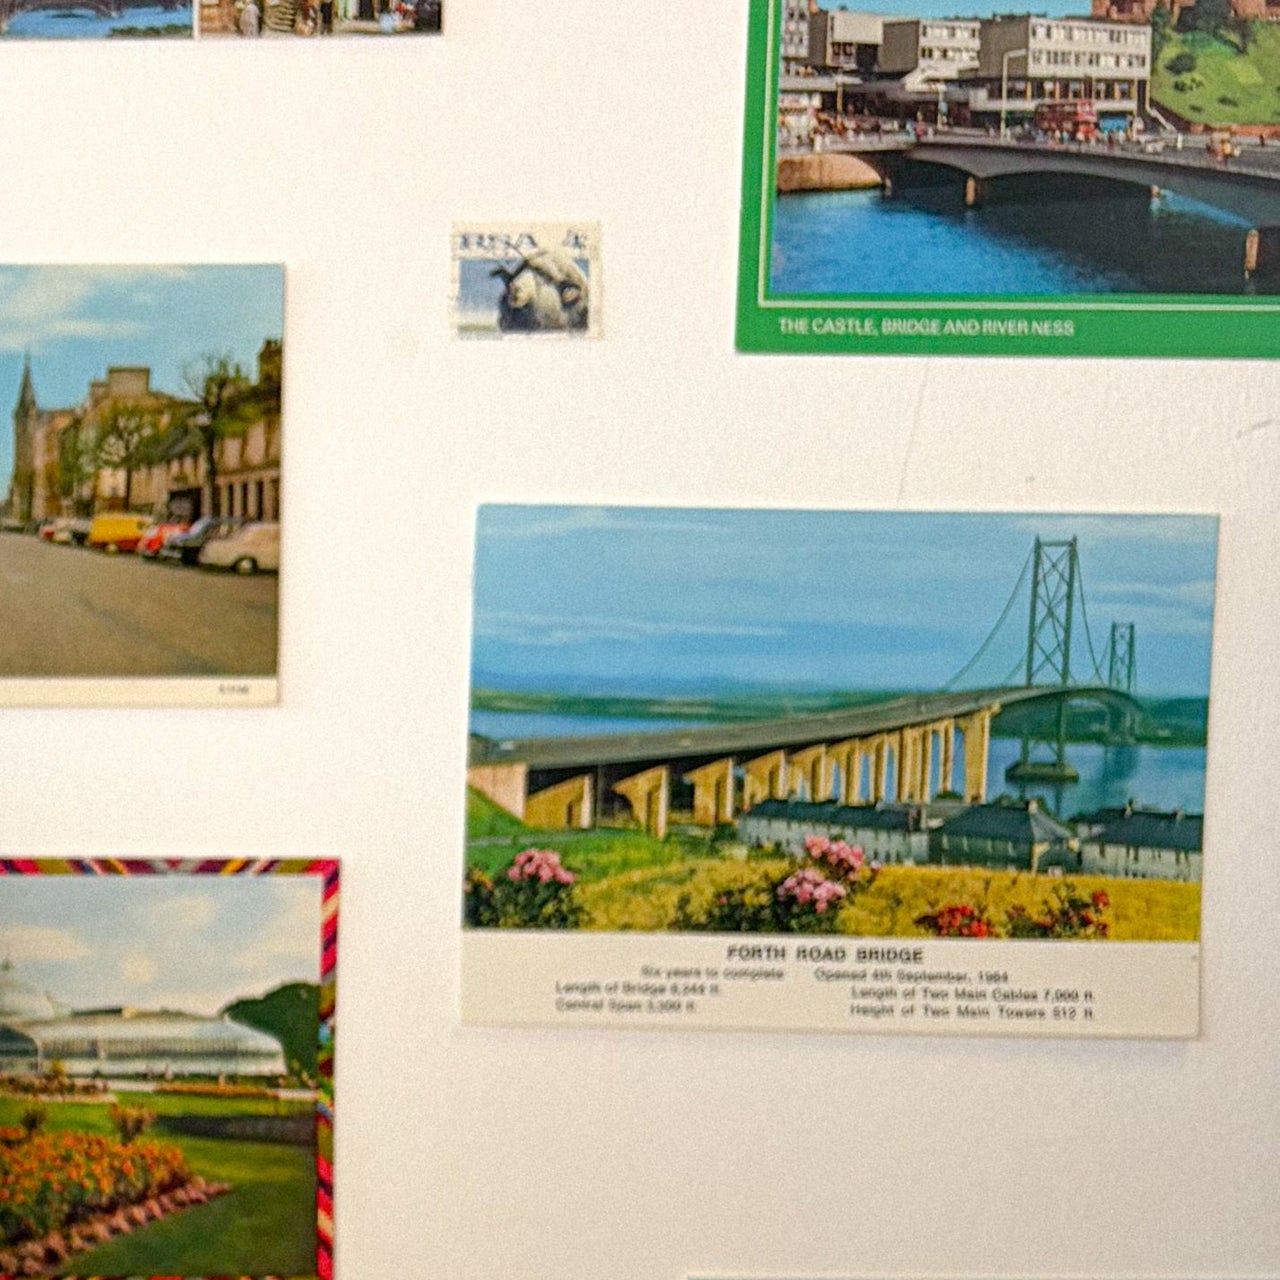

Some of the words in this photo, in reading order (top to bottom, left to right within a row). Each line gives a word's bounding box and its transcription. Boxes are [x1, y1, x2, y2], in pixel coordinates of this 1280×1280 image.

[780, 316, 808, 334] THE
[812, 317, 878, 336] CASTLE,
[881, 318, 940, 336] BRIDGE
[944, 319, 981, 336] AND
[982, 319, 1028, 336] RIVER
[1031, 319, 1075, 336] NESS
[726, 944, 786, 961] FORTH
[796, 945, 846, 962] ROAD
[856, 947, 924, 963] BRIDGE
[705, 965, 719, 977] to
[722, 966, 784, 981] complete
[814, 969, 867, 983] Opened
[871, 969, 892, 982] 4th
[555, 980, 601, 996] Length
[605, 981, 619, 994] of
[621, 981, 667, 997] Bridge
[851, 986, 898, 1002] Length
[902, 987, 916, 1000] of
[922, 987, 949, 1000] Two
[954, 987, 987, 1001] Main
[991, 989, 1039, 1002] Cables
[850, 1004, 894, 1019] Height
[901, 1004, 915, 1017] of
[922, 1005, 949, 1018] Two
[956, 1005, 990, 1019] Main
[998, 1006, 1045, 1020] Towers
